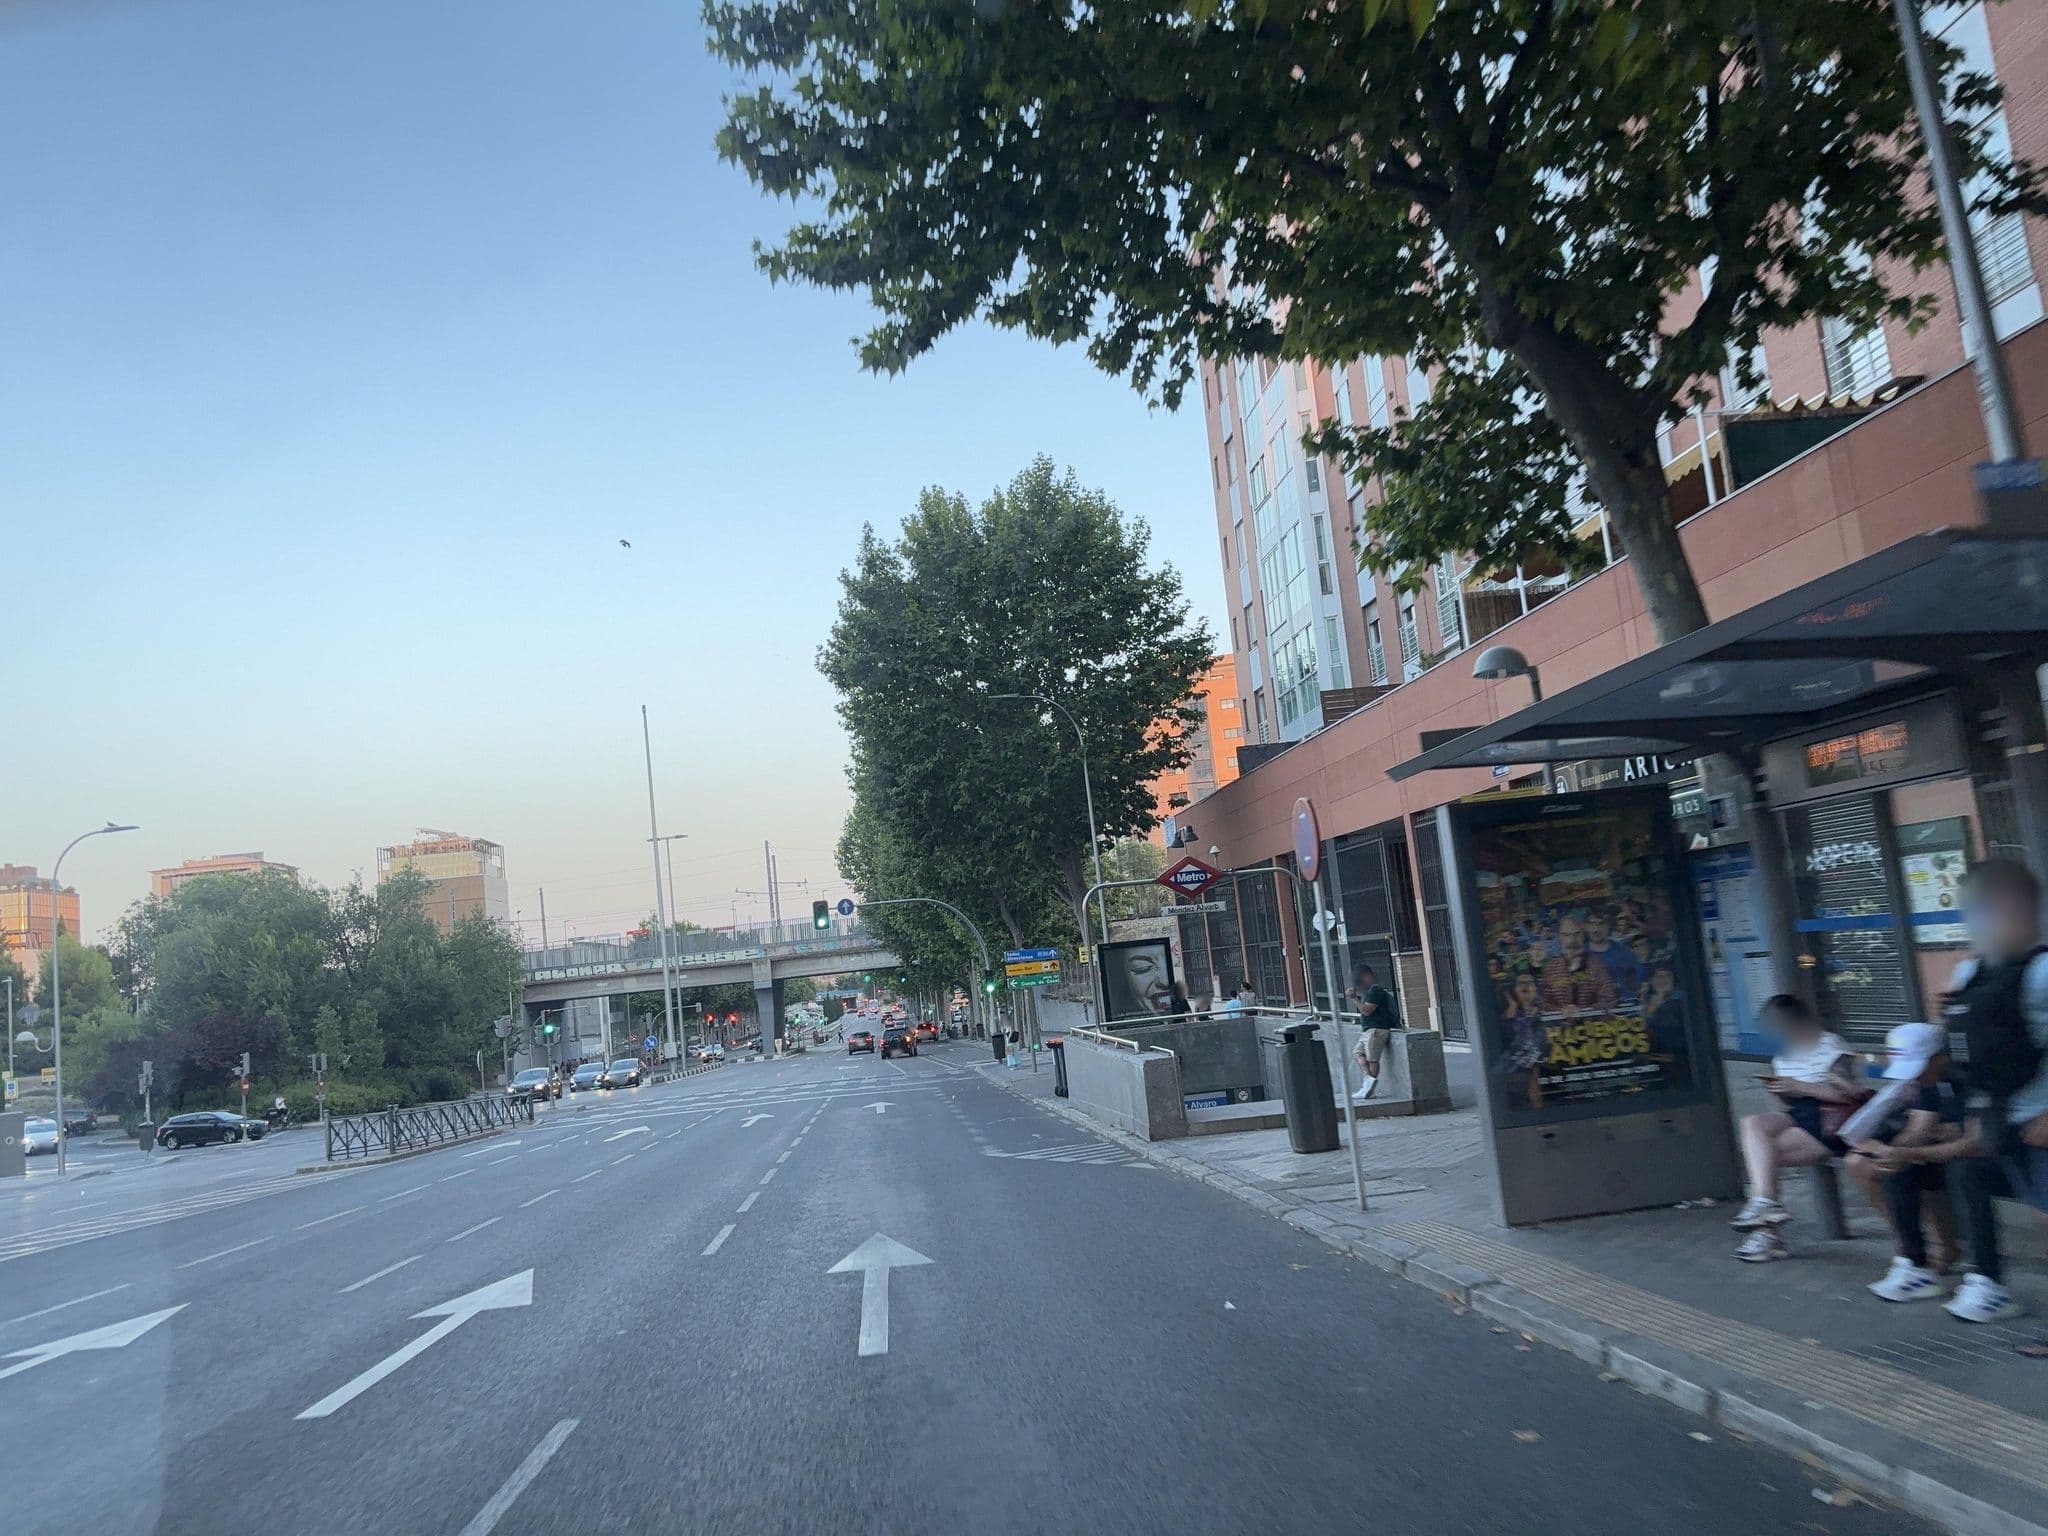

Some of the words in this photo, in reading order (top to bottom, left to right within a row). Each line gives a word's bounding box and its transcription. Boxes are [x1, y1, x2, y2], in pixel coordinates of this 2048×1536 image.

[1581, 769, 1619, 787] RESTAURANTE
[1176, 872, 1206, 883] Metro
[1547, 1016, 1646, 1044] HACIENDO
[1548, 1033, 1650, 1065] AMIGOS
